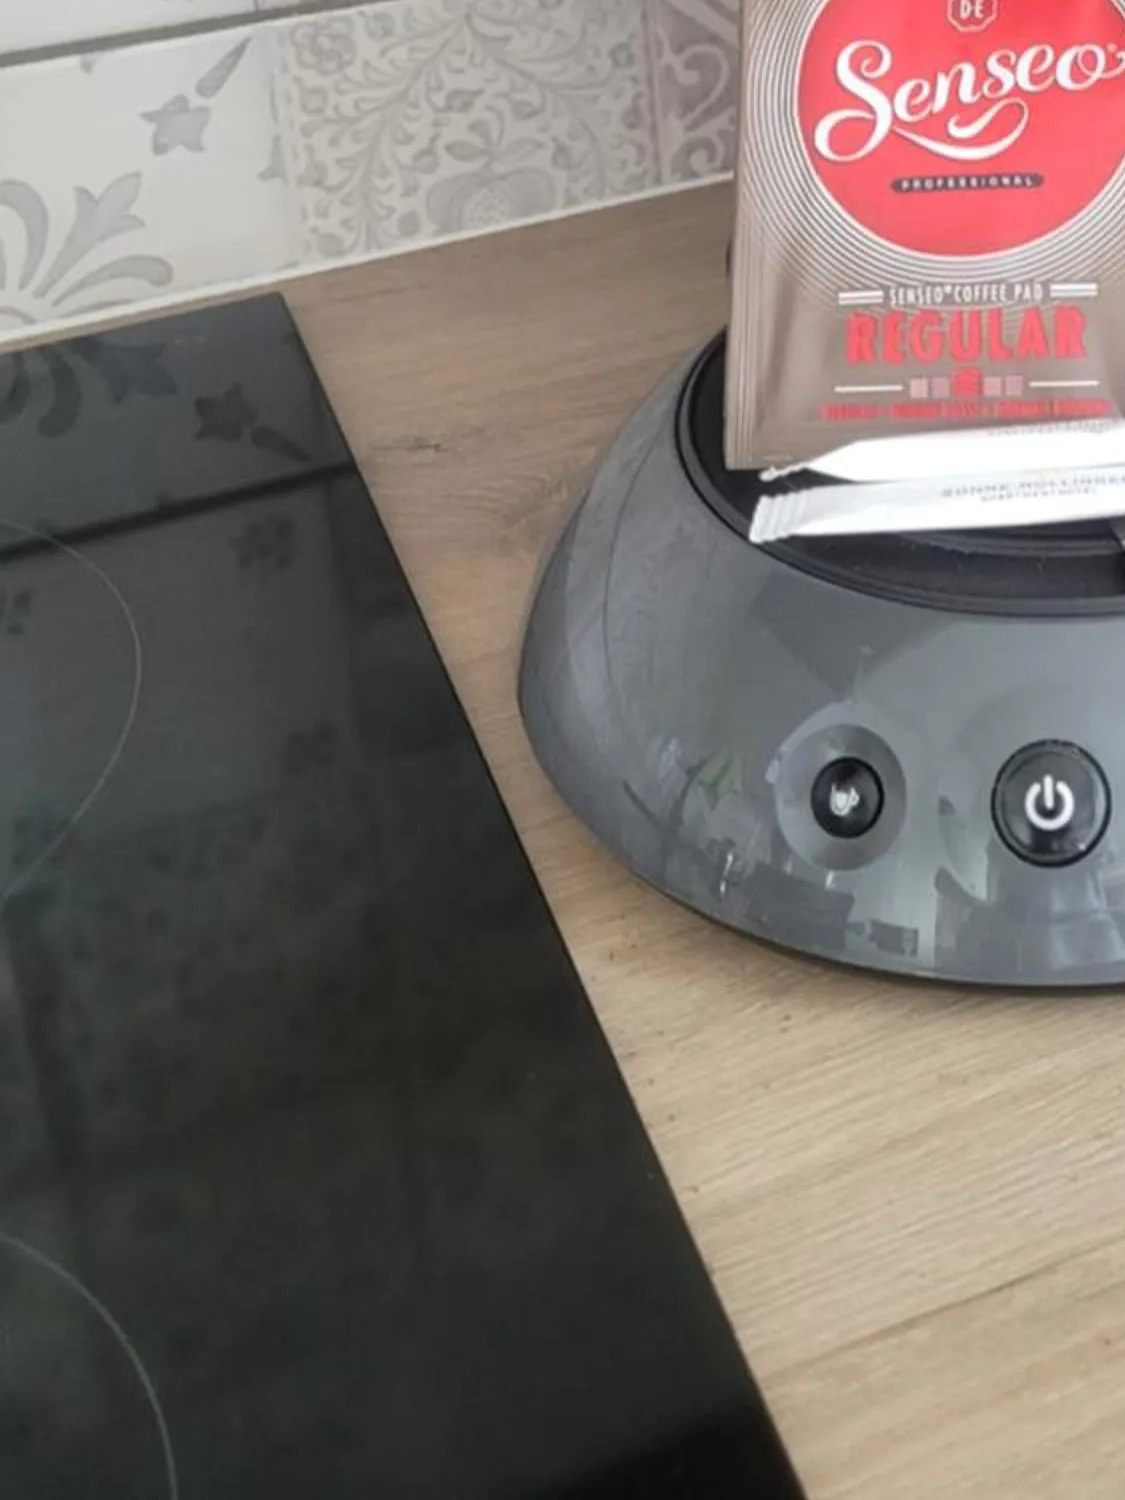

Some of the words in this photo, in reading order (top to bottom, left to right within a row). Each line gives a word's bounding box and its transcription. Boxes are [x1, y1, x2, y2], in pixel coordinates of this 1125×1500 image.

[954, 283, 1006, 303] COFFEE
[1014, 283, 1043, 301] PAD
[845, 304, 1086, 366] REGULAR
